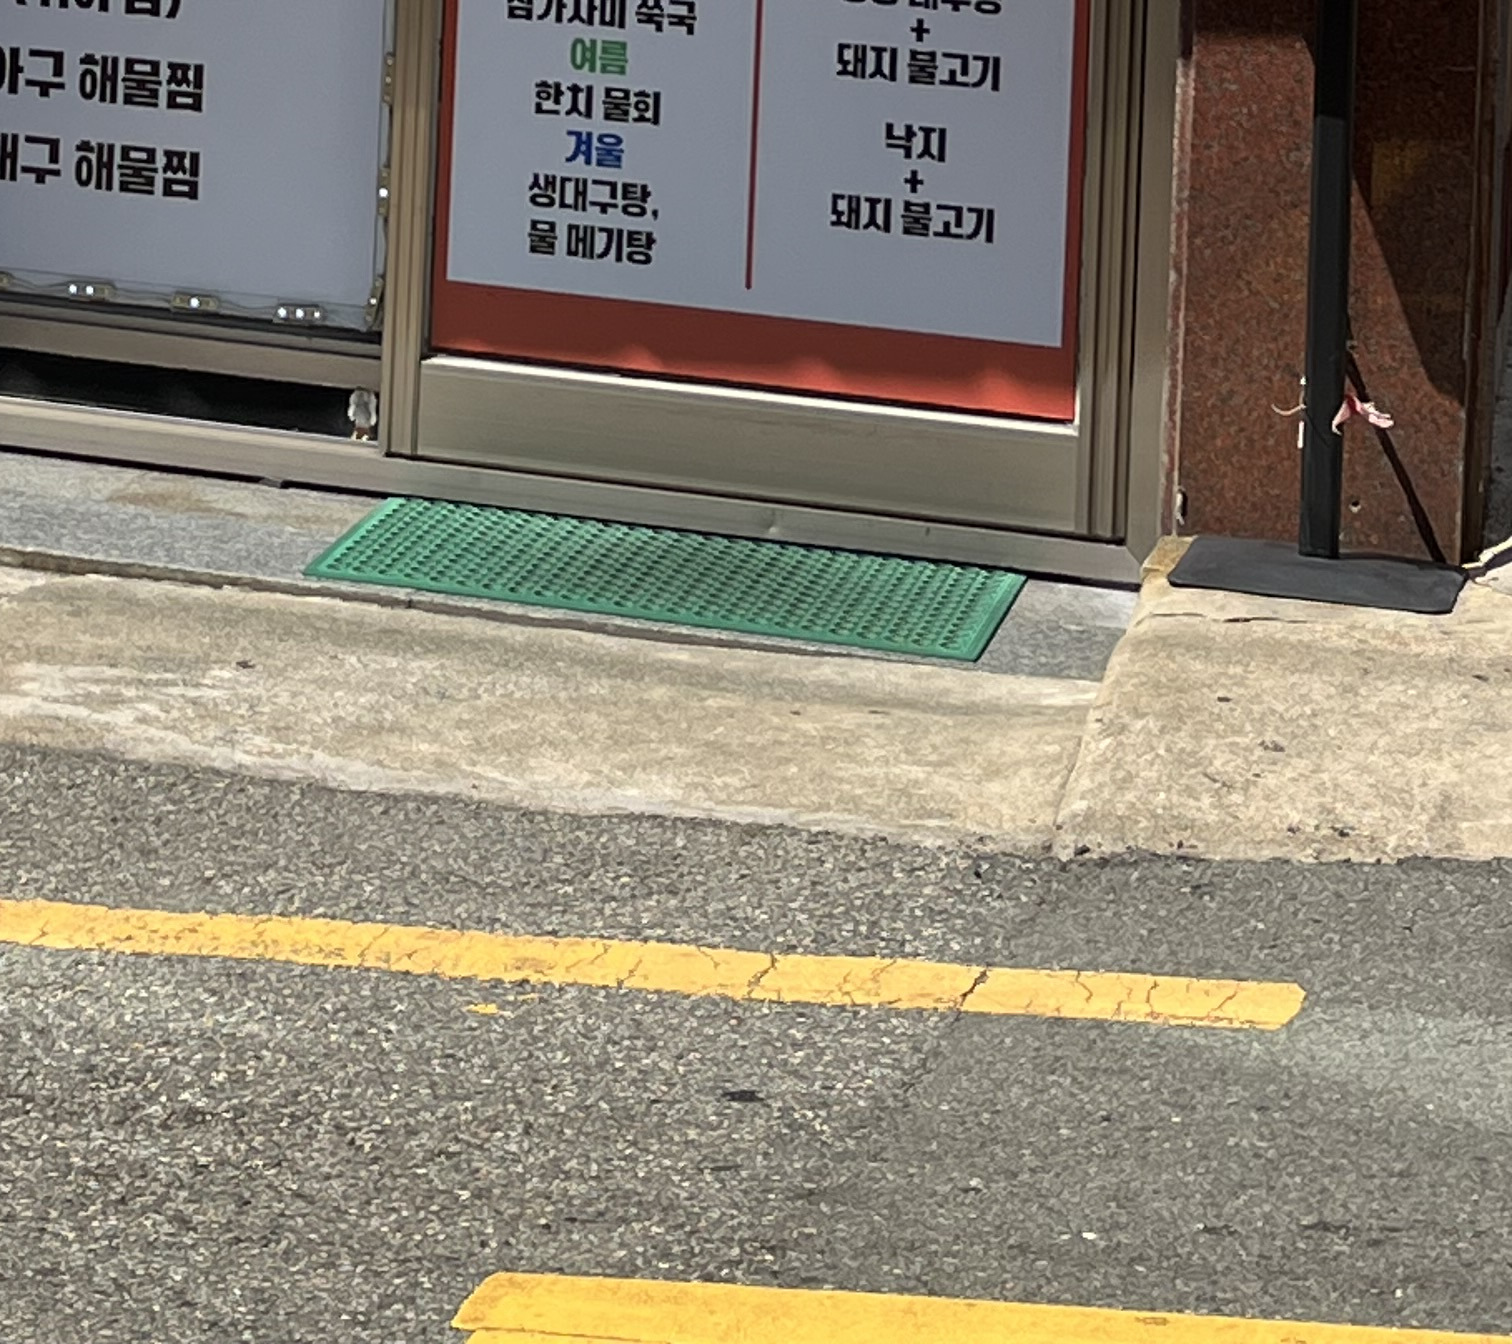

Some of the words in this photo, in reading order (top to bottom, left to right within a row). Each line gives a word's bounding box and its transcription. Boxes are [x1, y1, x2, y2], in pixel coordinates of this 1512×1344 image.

[569, 37, 629, 76] 여름
[835, 42, 898, 83] 돼지
[907, 48, 1002, 92] 불고기
[78, 51, 205, 113] 해물찜
[534, 80, 593, 118] 한치
[601, 86, 662, 126] 물회
[564, 129, 625, 170] 겨울
[884, 122, 947, 162] 낙지
[74, 138, 201, 200] 해물찜
[528, 173, 659, 220] 생대구탕,
[829, 193, 892, 233] 돼지
[900, 199, 995, 243] 불고기
[528, 219, 558, 256] 물
[565, 222, 656, 265] 메기탕
